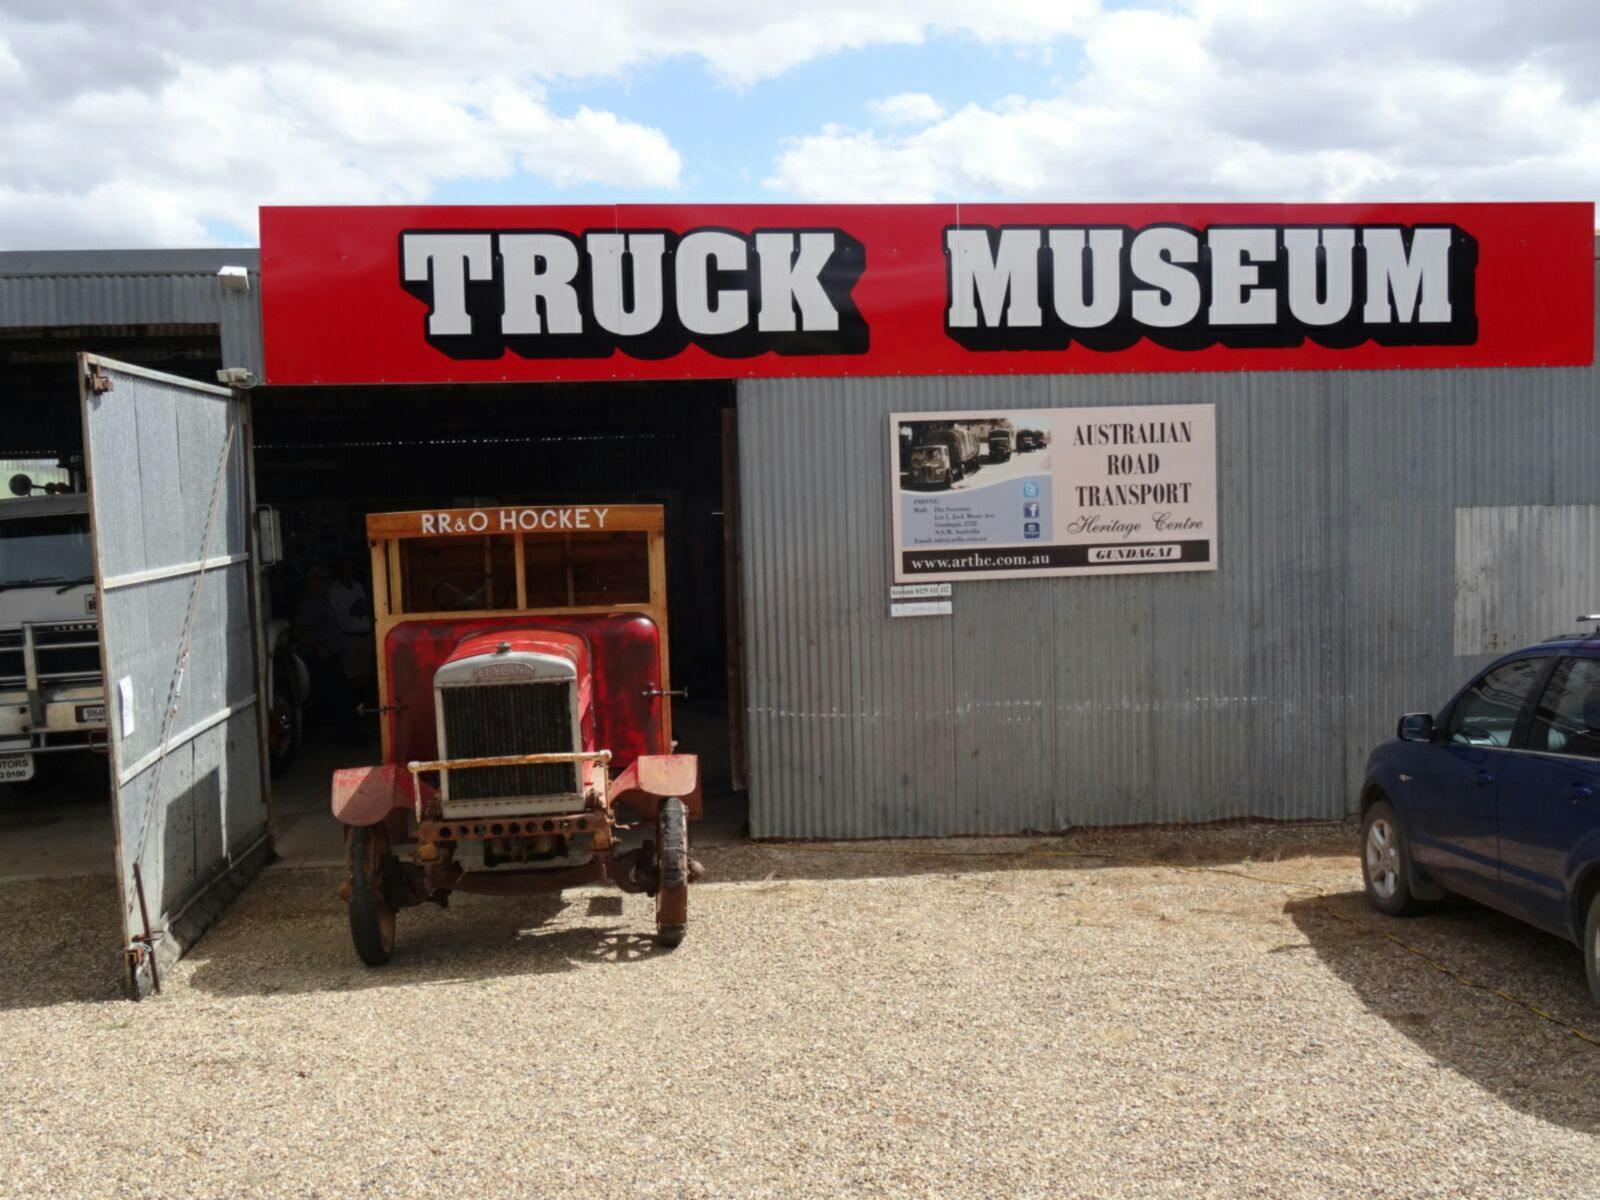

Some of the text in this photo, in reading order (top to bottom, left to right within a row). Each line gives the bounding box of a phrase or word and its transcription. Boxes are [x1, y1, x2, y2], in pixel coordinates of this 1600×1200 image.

[401, 226, 1460, 343] TRUCK MUSEUM
[1072, 421, 1192, 446] AUSTRALIAN
[1107, 453, 1160, 475] ROAD
[1075, 482, 1192, 507] TRANSPORT
[500, 508, 609, 531] HOCKEY
[1066, 511, 1203, 539] Heritage Centre
[911, 547, 1173, 570] www.arthc.com.au GUNDAGAI
